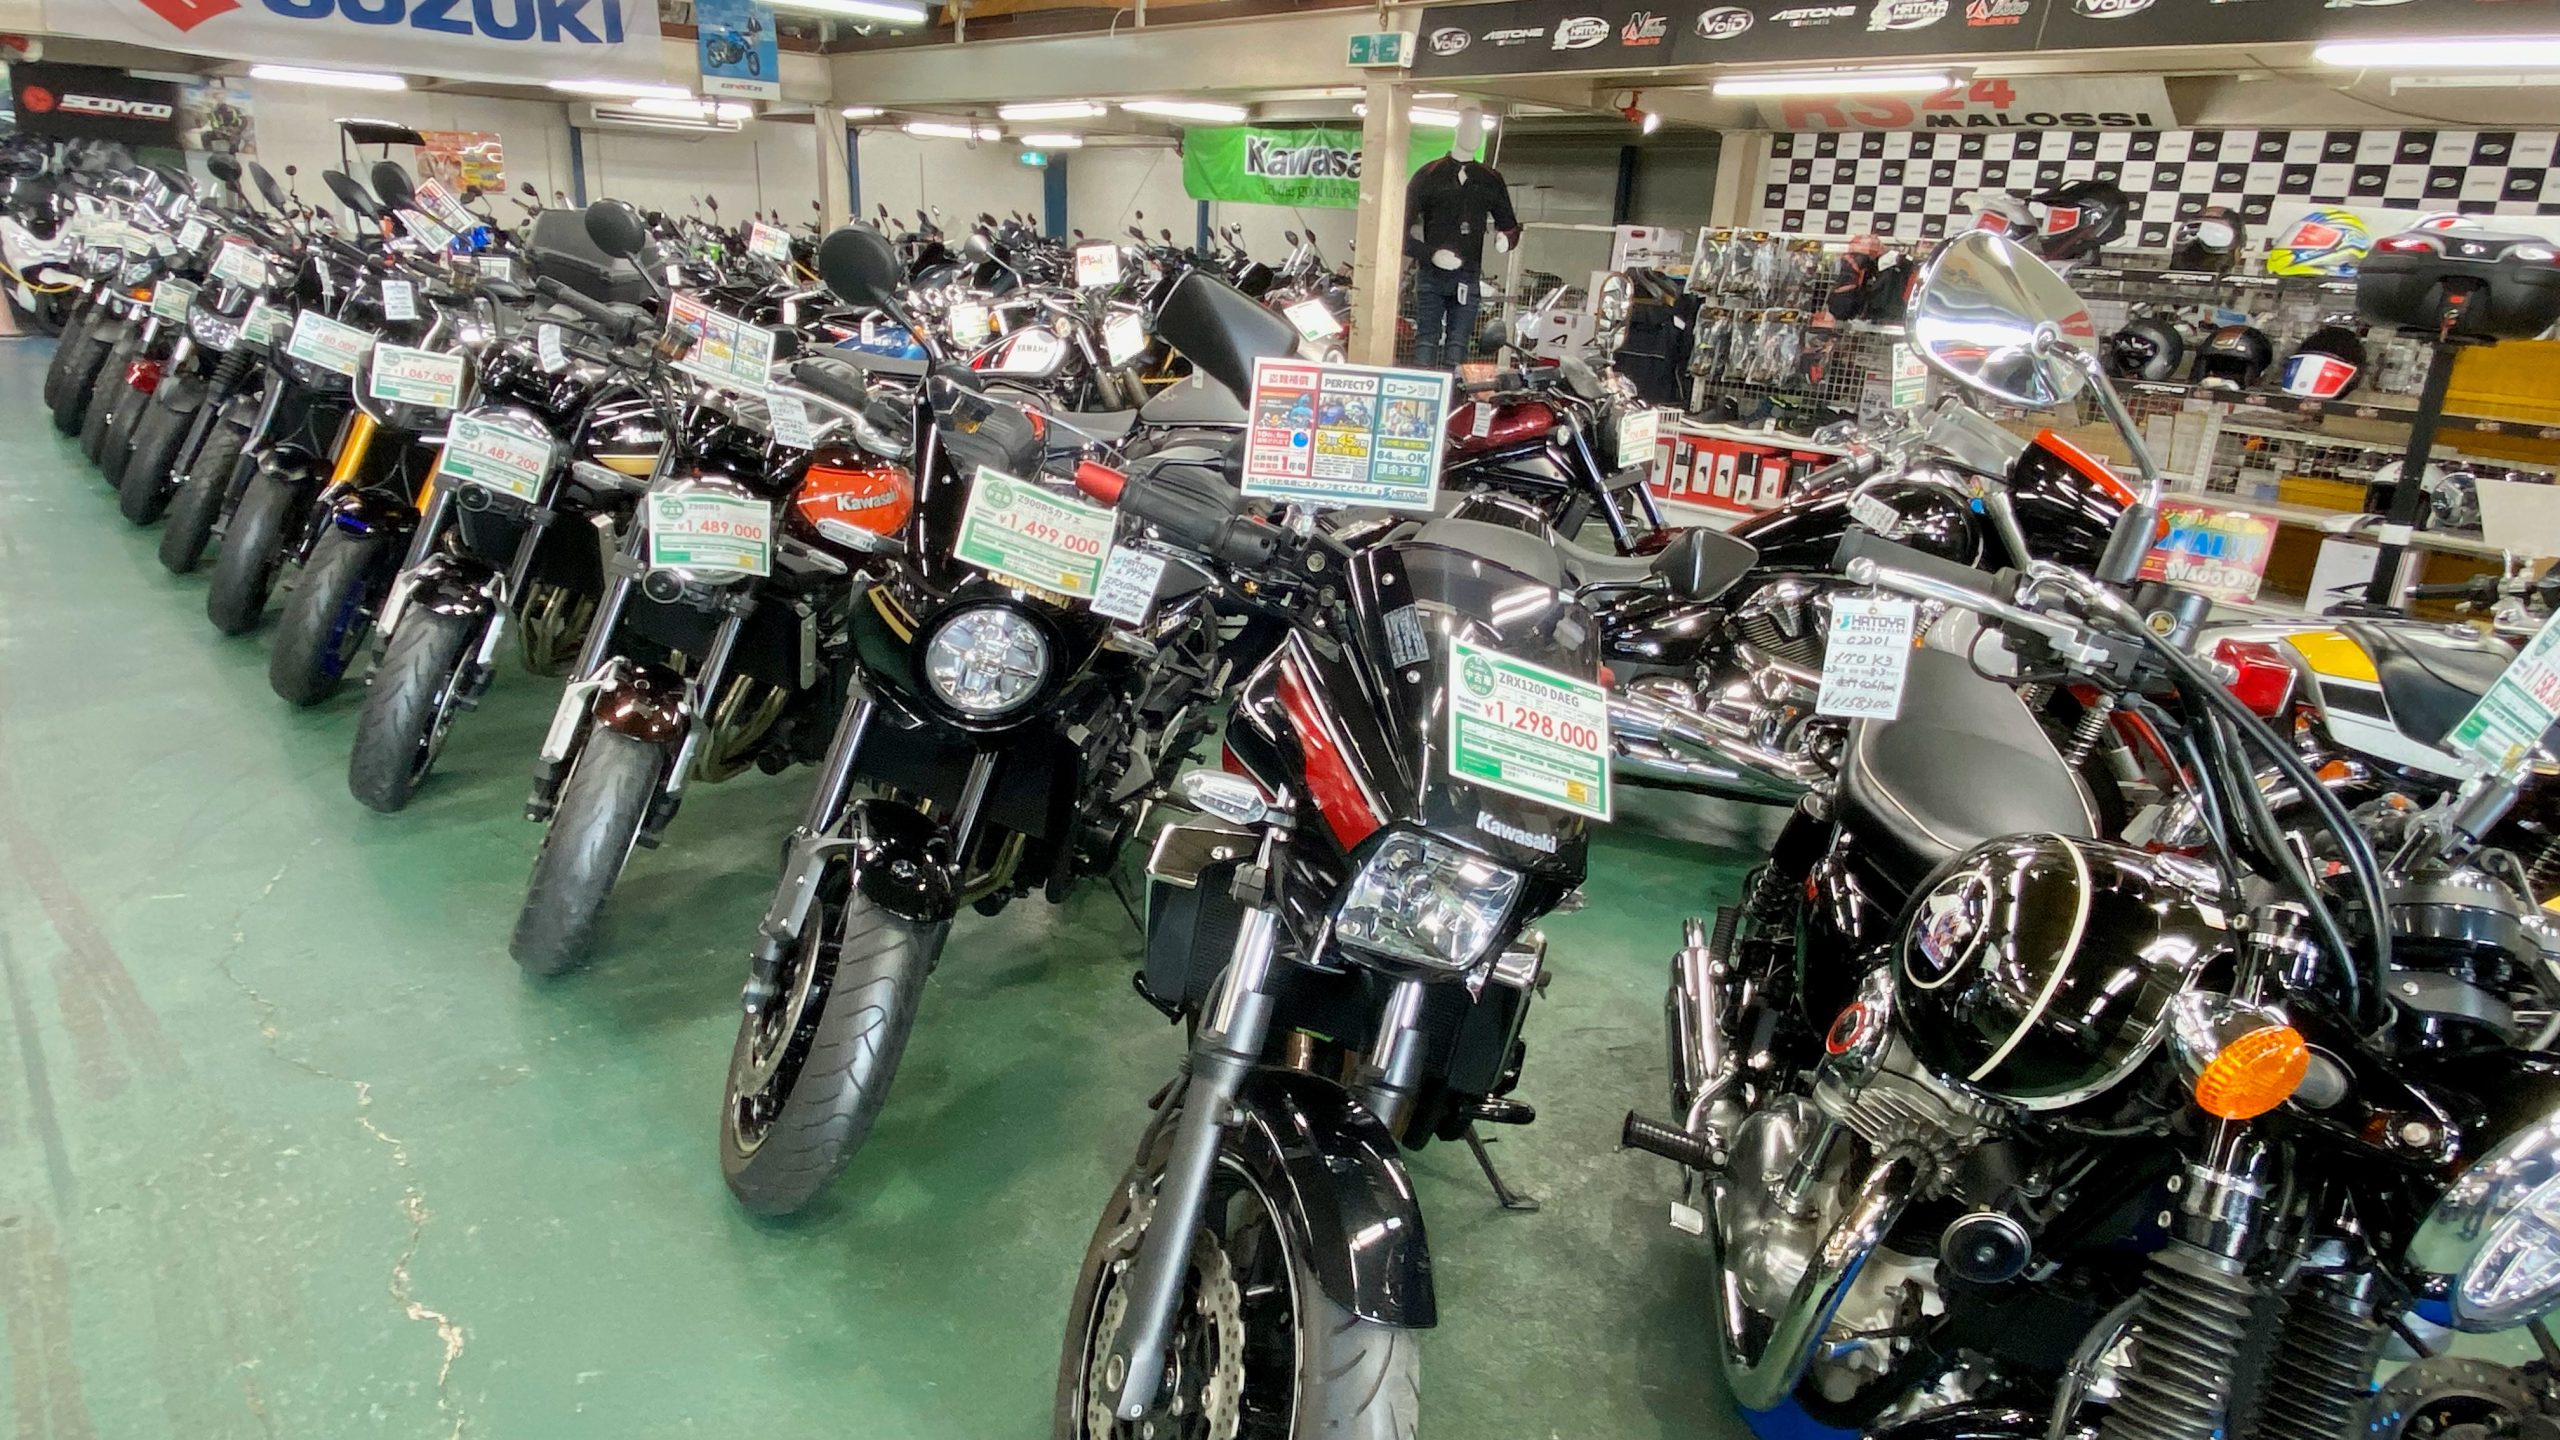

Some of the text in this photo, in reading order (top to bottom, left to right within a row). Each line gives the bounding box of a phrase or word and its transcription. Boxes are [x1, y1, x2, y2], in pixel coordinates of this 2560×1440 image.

[1768, 5, 1857, 21] ASTONE
[1482, 27, 1545, 41] ASTONE
[61, 93, 173, 119] SCOYCO
[1926, 111, 2154, 129] MALOSSI
[836, 488, 898, 512] Kawasaki
[677, 519, 762, 541] ¥1,489,000
[999, 512, 1101, 556] ¥1,499,000
[1851, 614, 1906, 629] HATOYA
[1464, 668, 1493, 688] 中古車
[1498, 671, 1580, 708] ZRX1200 DAEG
[1484, 700, 1599, 753] ¥1,298,000
[1476, 810, 1558, 854] Kawasaki
